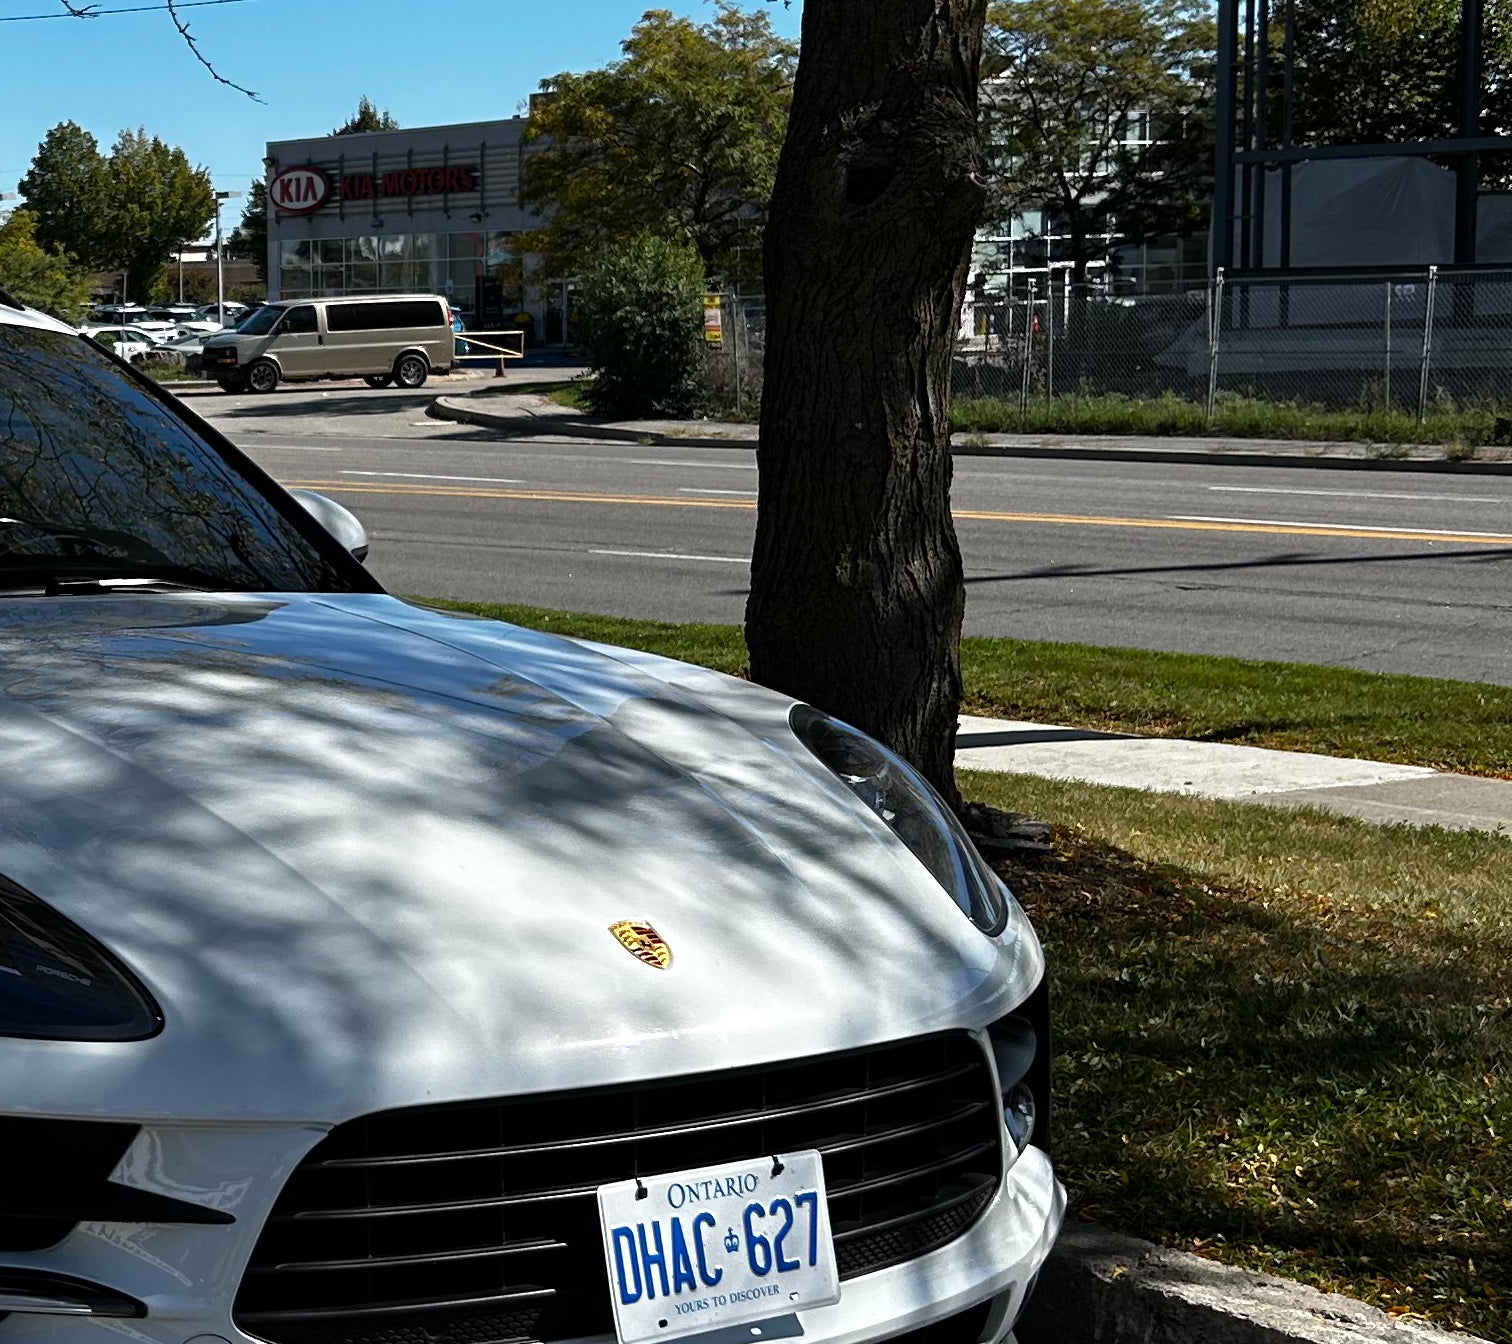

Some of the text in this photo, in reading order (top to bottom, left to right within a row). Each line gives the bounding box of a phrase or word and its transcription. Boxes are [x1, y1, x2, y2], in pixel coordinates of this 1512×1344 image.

[279, 176, 317, 203] KIA
[340, 166, 472, 199] KIA MOTORS
[667, 1173, 757, 1209] ONTARIO
[611, 1189, 818, 1305] DHAC 627
[675, 1284, 780, 1315] YOURS TO DISCOVER
